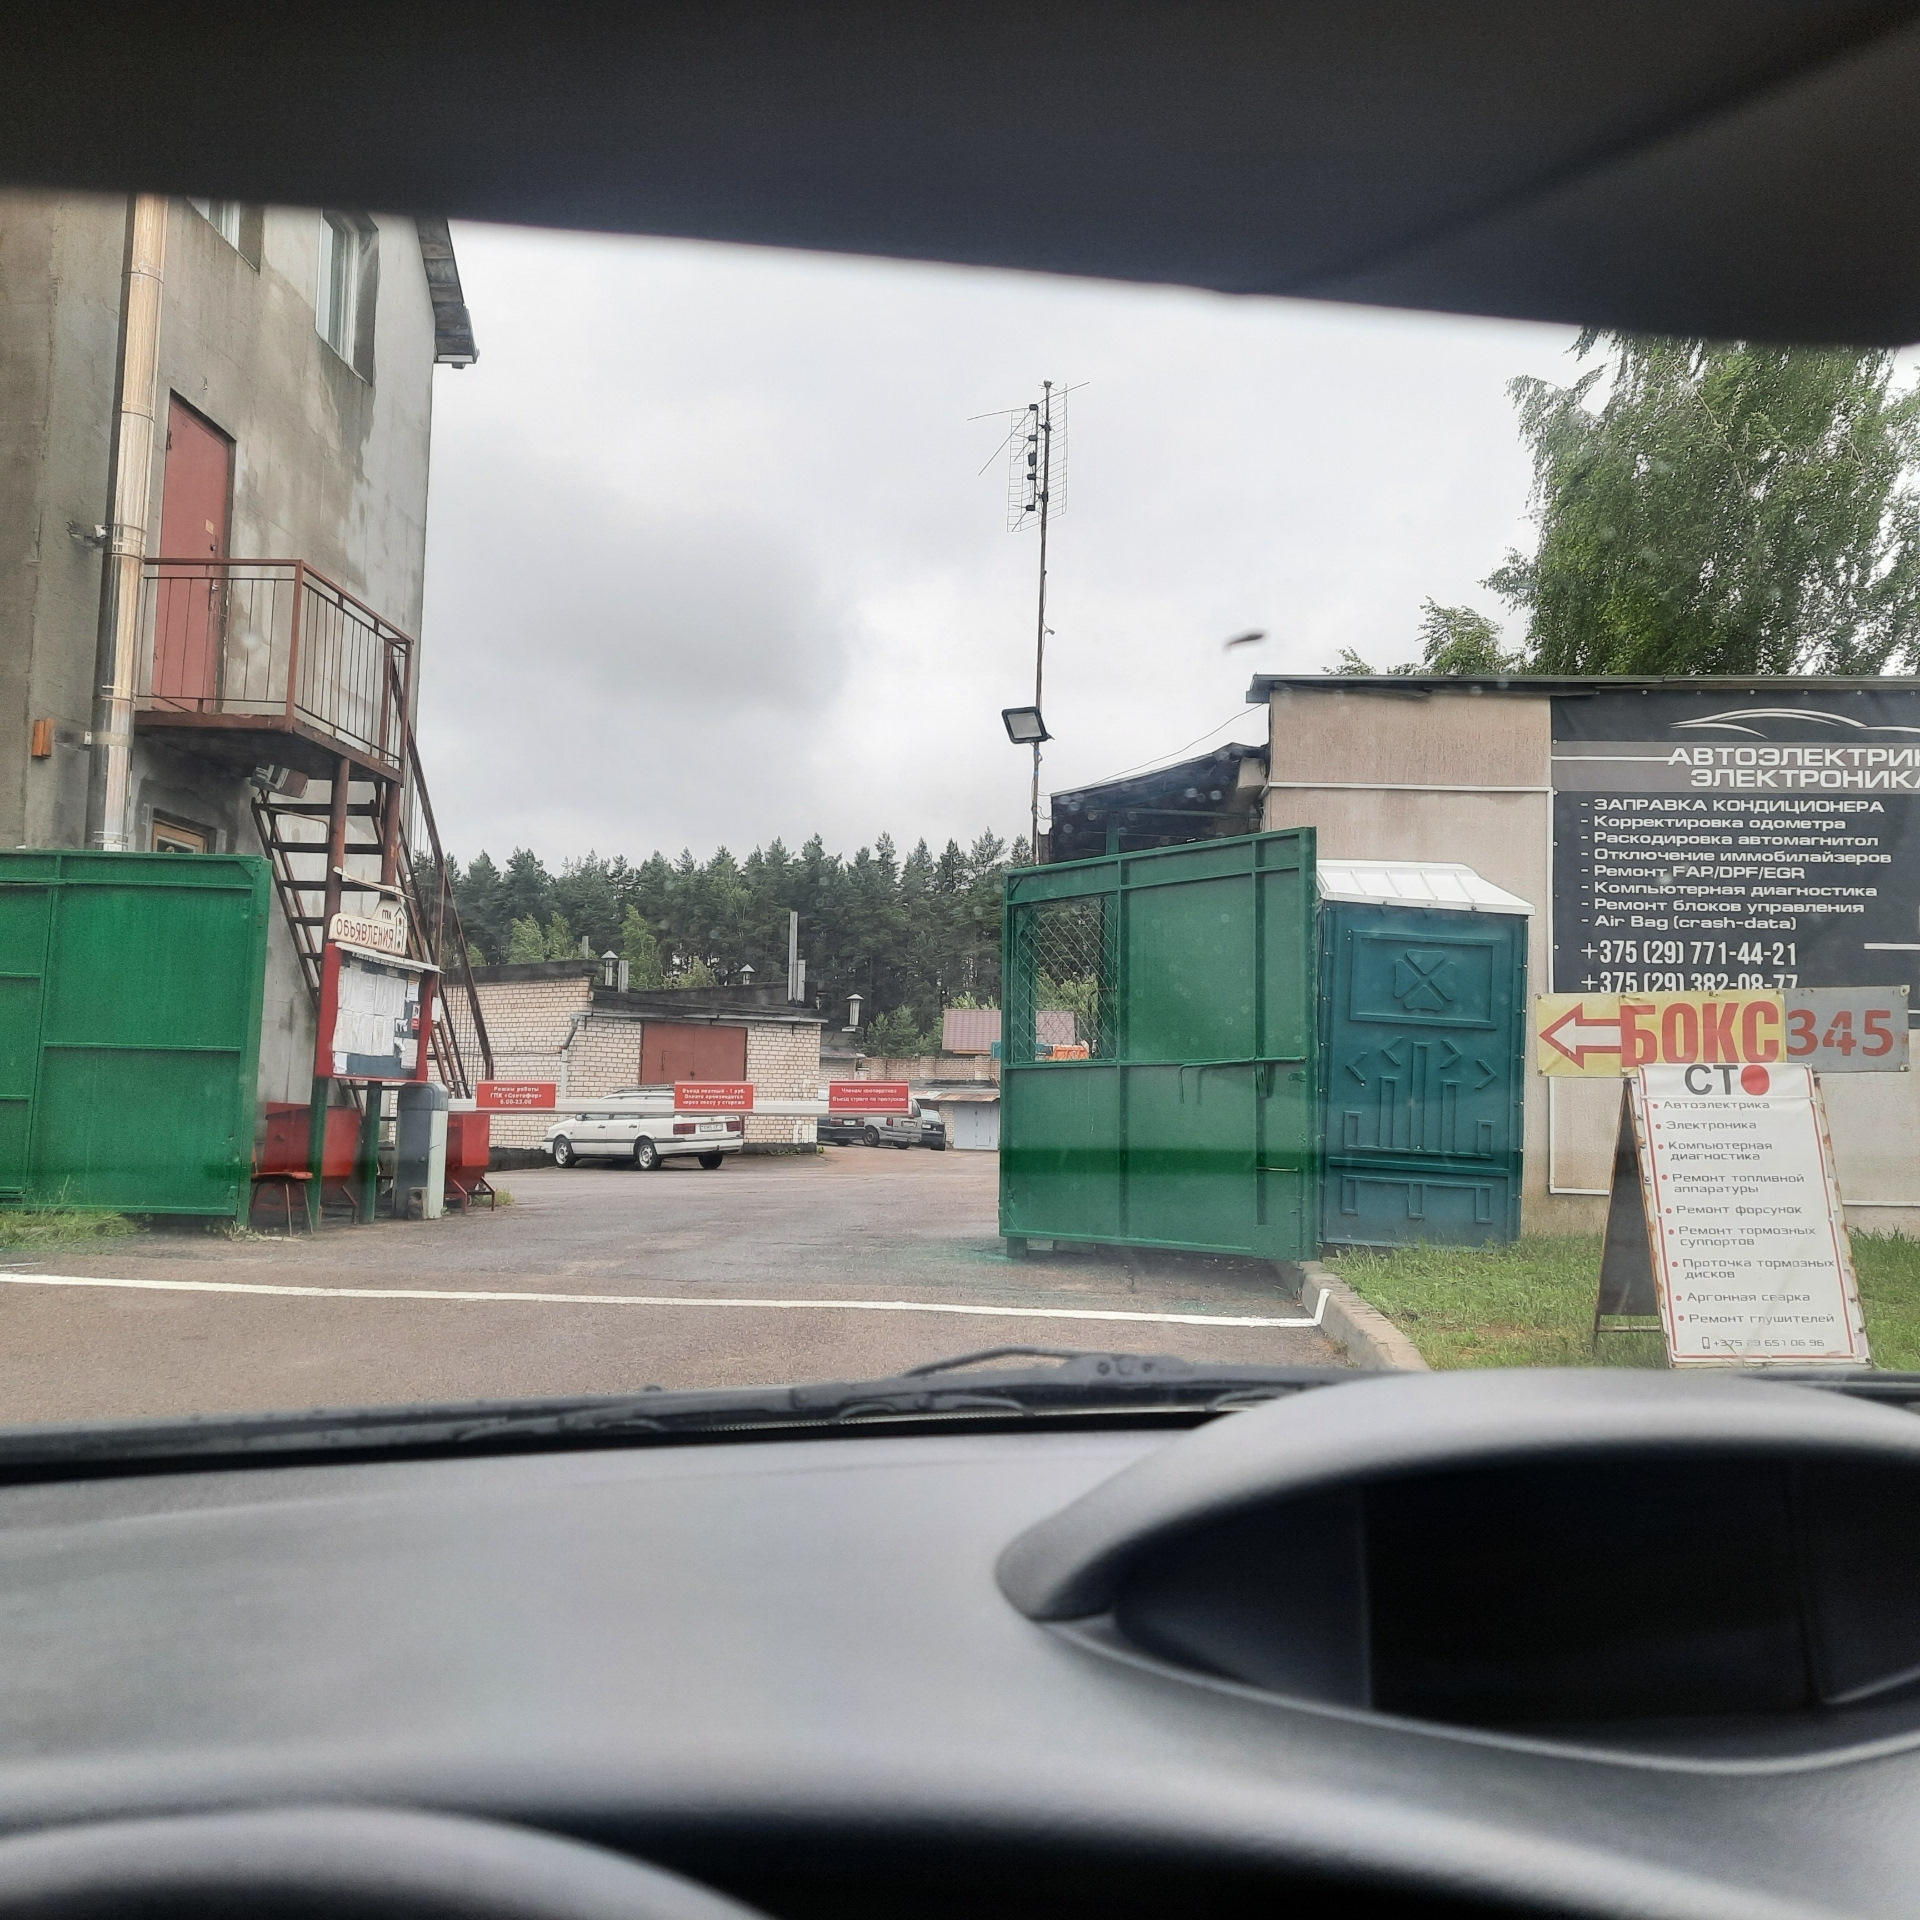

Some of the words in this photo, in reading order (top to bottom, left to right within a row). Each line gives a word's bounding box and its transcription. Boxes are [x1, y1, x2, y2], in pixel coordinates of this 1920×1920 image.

[1594, 798, 1707, 811] ЗАПРАВКА
[1713, 799, 1885, 814] КОНДИЦИОНЕРА
[1594, 815, 1743, 830] Корректировка
[1749, 819, 1846, 831] одометра
[1594, 831, 1732, 846] Раскодировка
[1738, 835, 1878, 846] автомагнитол
[1594, 848, 1715, 861] Отключение
[1720, 851, 1892, 865] иммобилайзеров
[1594, 865, 1667, 877] Ремонт
[1673, 865, 1805, 880] FAP/DPF/EGR
[1594, 881, 1745, 897] Компьютерная
[1750, 886, 1877, 897] диагностика
[1595, 898, 1667, 911] Ремонт
[1673, 899, 1741, 912] блоков
[1747, 902, 1864, 915] управления
[1595, 915, 1625, 928] Air
[1631, 916, 1668, 931] Bag
[1673, 916, 1797, 931] (crash-data)
[336, 918, 394, 949] ОБЪЯВЛЕНИЯ
[1581, 940, 1637, 964] +375
[1643, 940, 1684, 965] (29)
[1690, 941, 1796, 966] 771-44-21
[1581, 971, 1637, 993] +375
[1643, 972, 1684, 992] (29)
[1690, 973, 1798, 991] 382-08-77
[1620, 1001, 1780, 1068] БОКС
[1786, 1009, 1894, 1057] 345
[1663, 1101, 1770, 1110] Автоэлектрика
[1666, 1121, 1757, 1131] Электроника
[1668, 1141, 1773, 1151] Компьютерная
[1671, 1153, 1760, 1161] диагностика
[1672, 1173, 1726, 1183] Ремонт
[1731, 1174, 1805, 1183] топливной
[1674, 1185, 1759, 1195] аппаратуры
[1676, 1205, 1730, 1214] Ремонт
[1735, 1205, 1803, 1216] форсунок
[1678, 1226, 1733, 1235] Ремонт
[1738, 1227, 1816, 1237] тормозных
[1680, 1238, 1755, 1248] суппортов
[1682, 1258, 1751, 1270] Проточка
[1757, 1260, 1835, 1270] тормозных
[1685, 1271, 1735, 1280] дисков
[1687, 1292, 1757, 1303] Аргонная
[1761, 1294, 1811, 1303] сварка
[1689, 1314, 1744, 1323] Ремонт
[1750, 1313, 1835, 1326] глушителей
